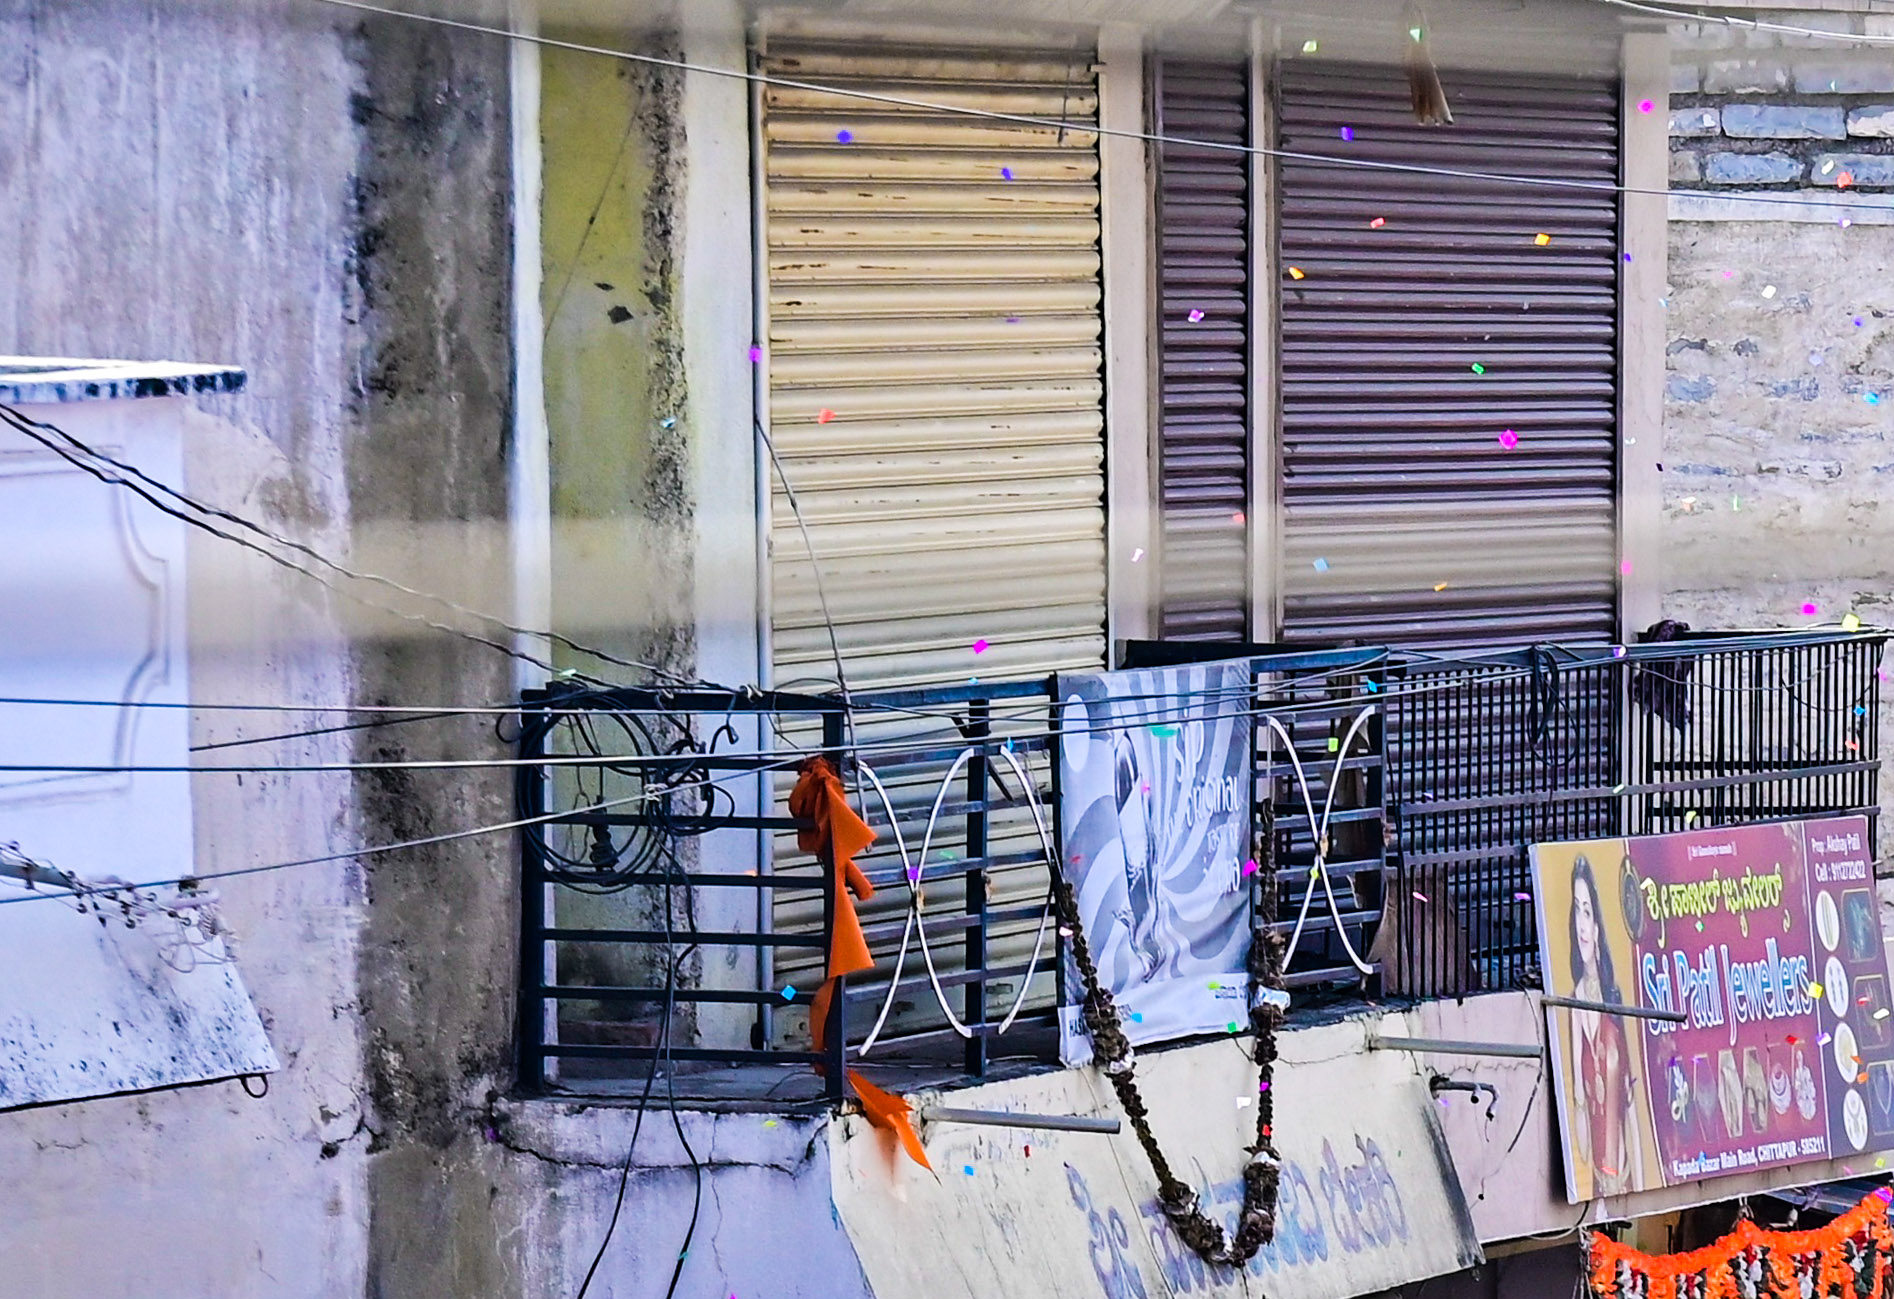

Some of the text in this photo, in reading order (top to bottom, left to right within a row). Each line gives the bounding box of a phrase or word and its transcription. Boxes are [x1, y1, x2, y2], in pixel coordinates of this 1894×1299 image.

[1642, 937, 1814, 1046] Sri Patil Jewellers
